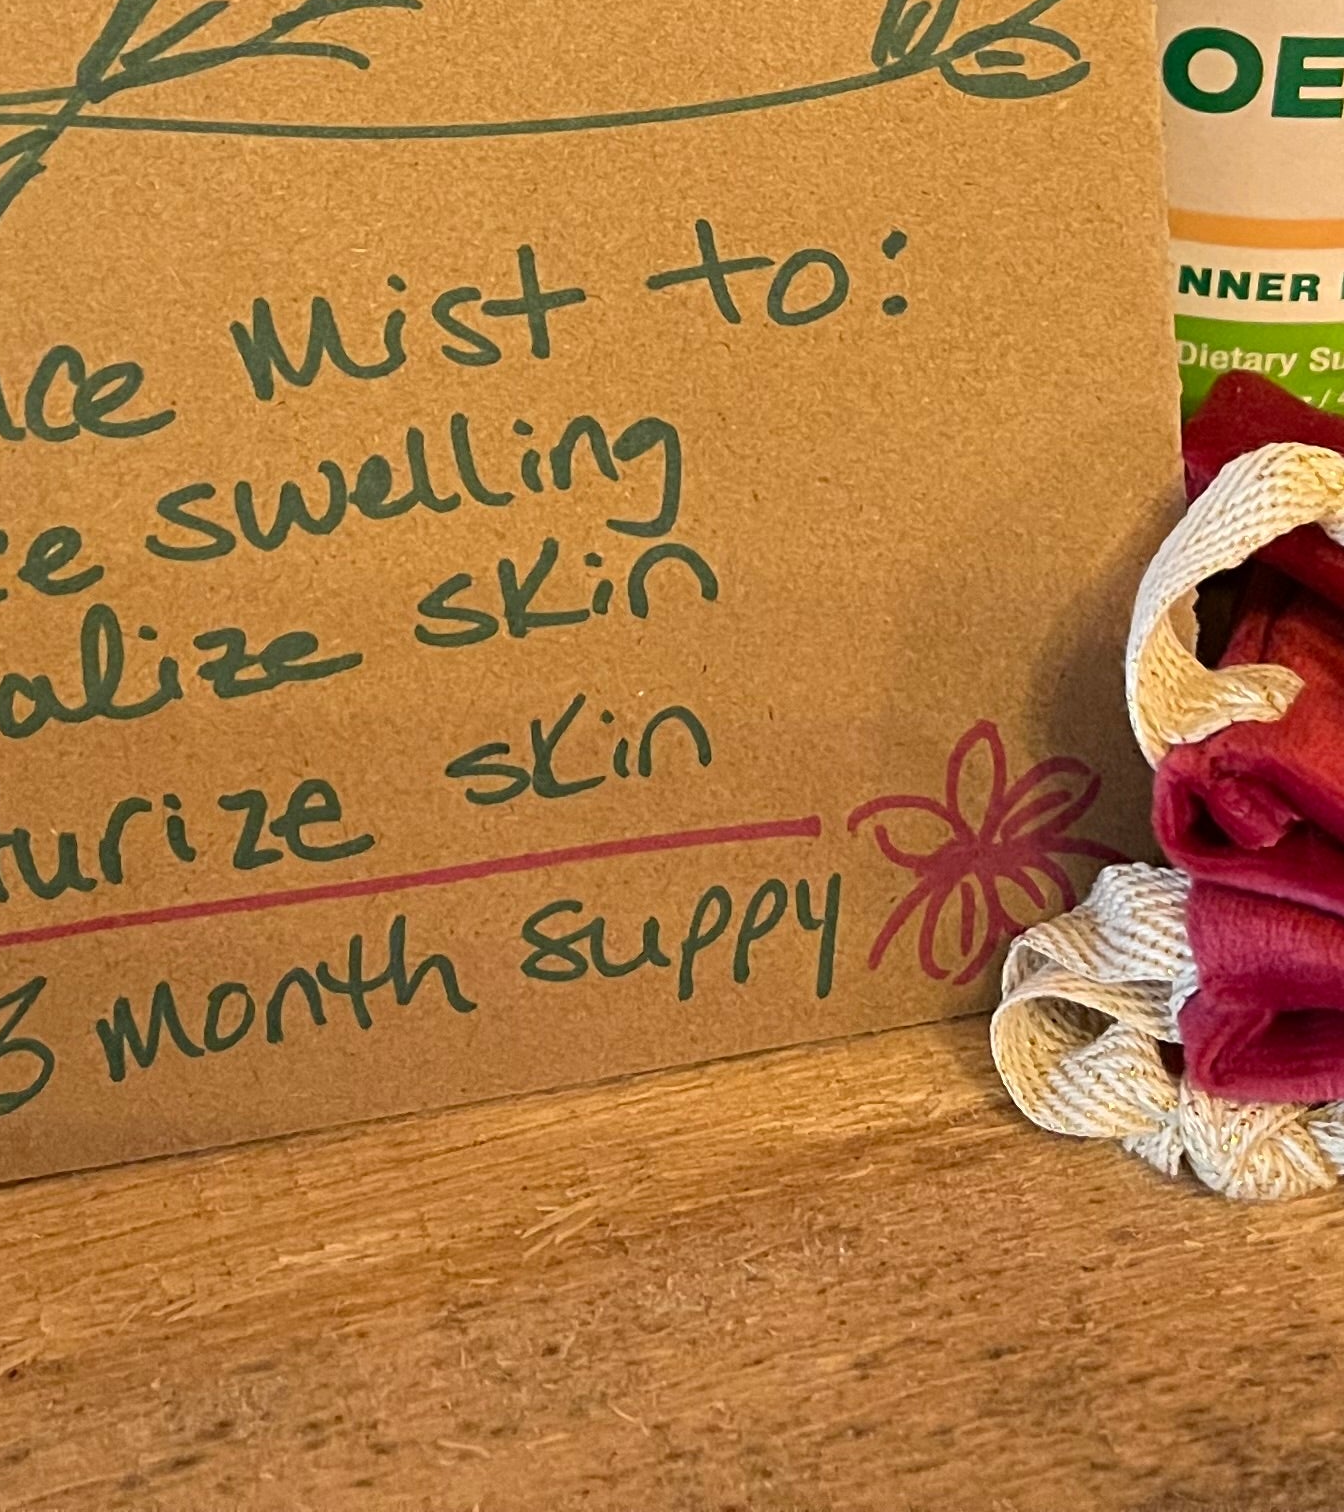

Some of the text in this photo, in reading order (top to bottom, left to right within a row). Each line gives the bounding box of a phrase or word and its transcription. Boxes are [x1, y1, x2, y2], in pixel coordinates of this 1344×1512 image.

[645, 218, 910, 326] to:
[1176, 340, 1298, 378] Dietary
[144, 412, 683, 562] swelling
[520, 872, 843, 1002] suppy
